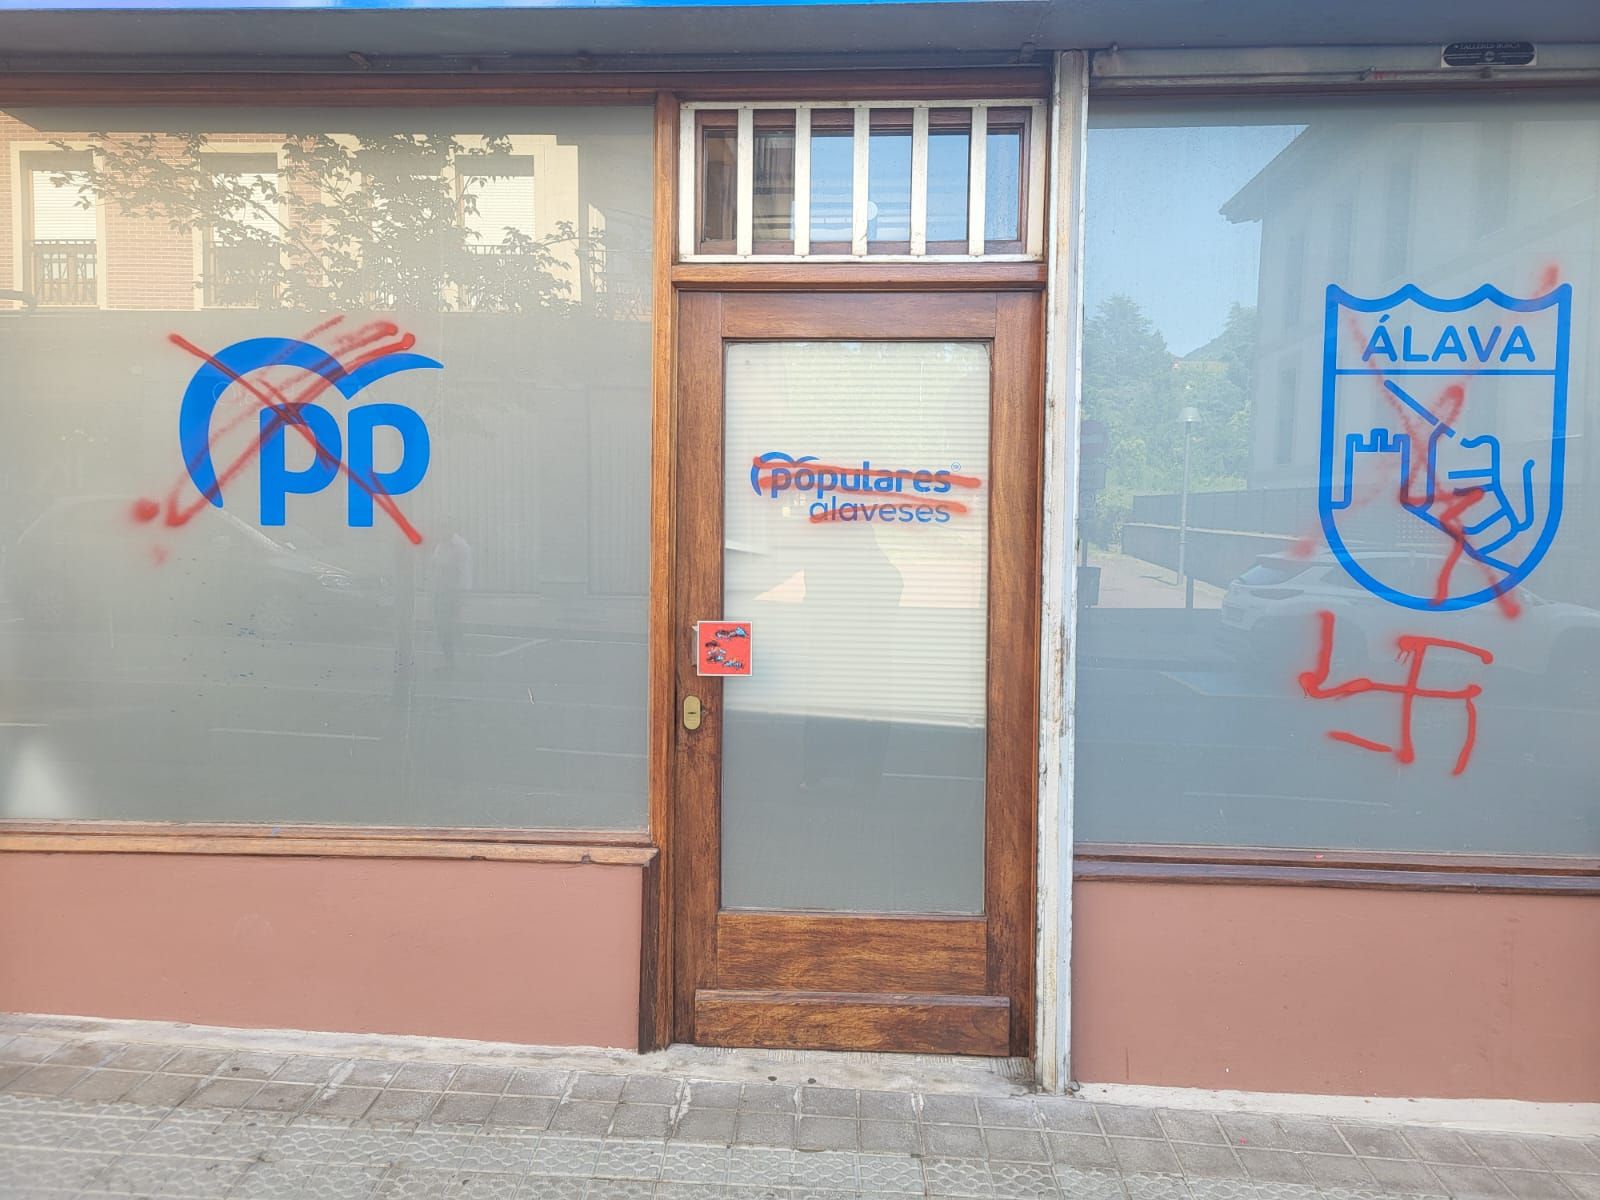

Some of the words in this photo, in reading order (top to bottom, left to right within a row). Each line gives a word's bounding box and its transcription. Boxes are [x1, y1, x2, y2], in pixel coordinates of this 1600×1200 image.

[1361, 313, 1536, 363] ÁLAVA
[771, 461, 951, 499] populares
[809, 495, 951, 523] alaveses
